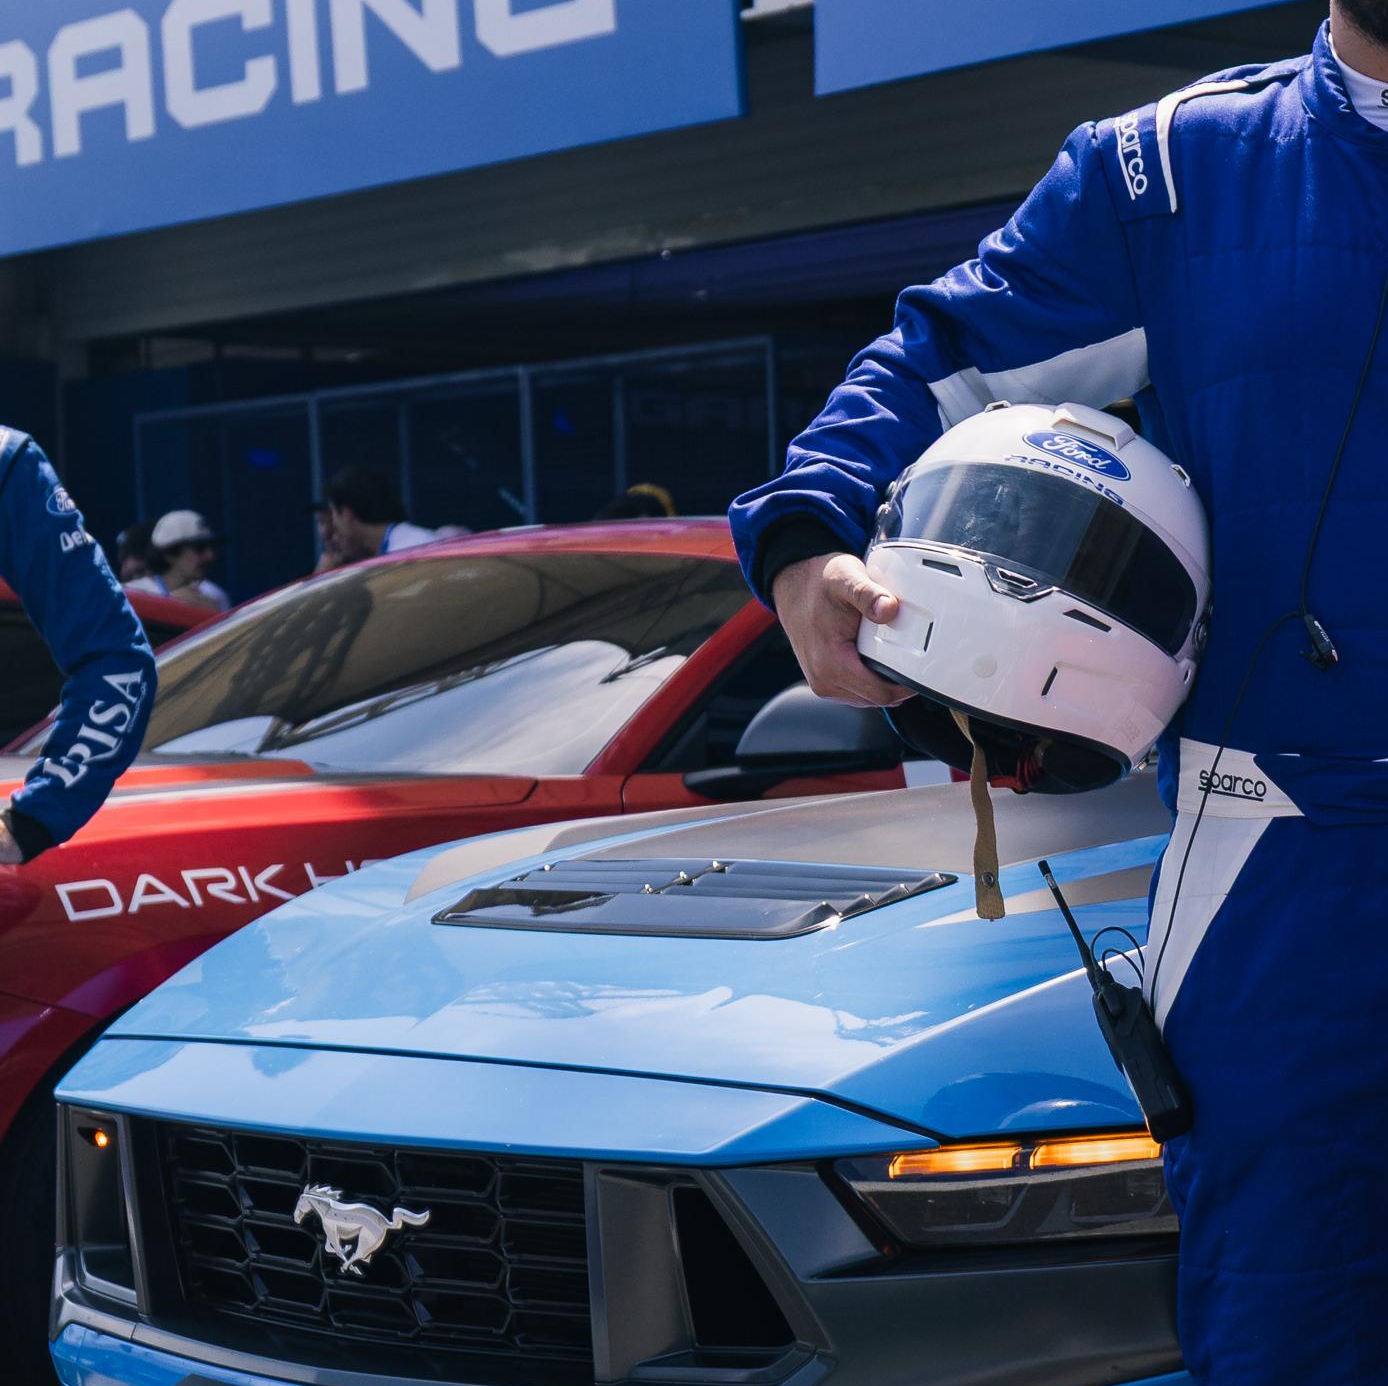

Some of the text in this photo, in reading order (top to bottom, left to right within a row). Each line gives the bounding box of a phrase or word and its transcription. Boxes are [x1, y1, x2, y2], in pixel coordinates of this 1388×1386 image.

[1042, 435, 1112, 470] Ford
[1198, 769, 1267, 800] sparco
[55, 863, 298, 923] DARK
